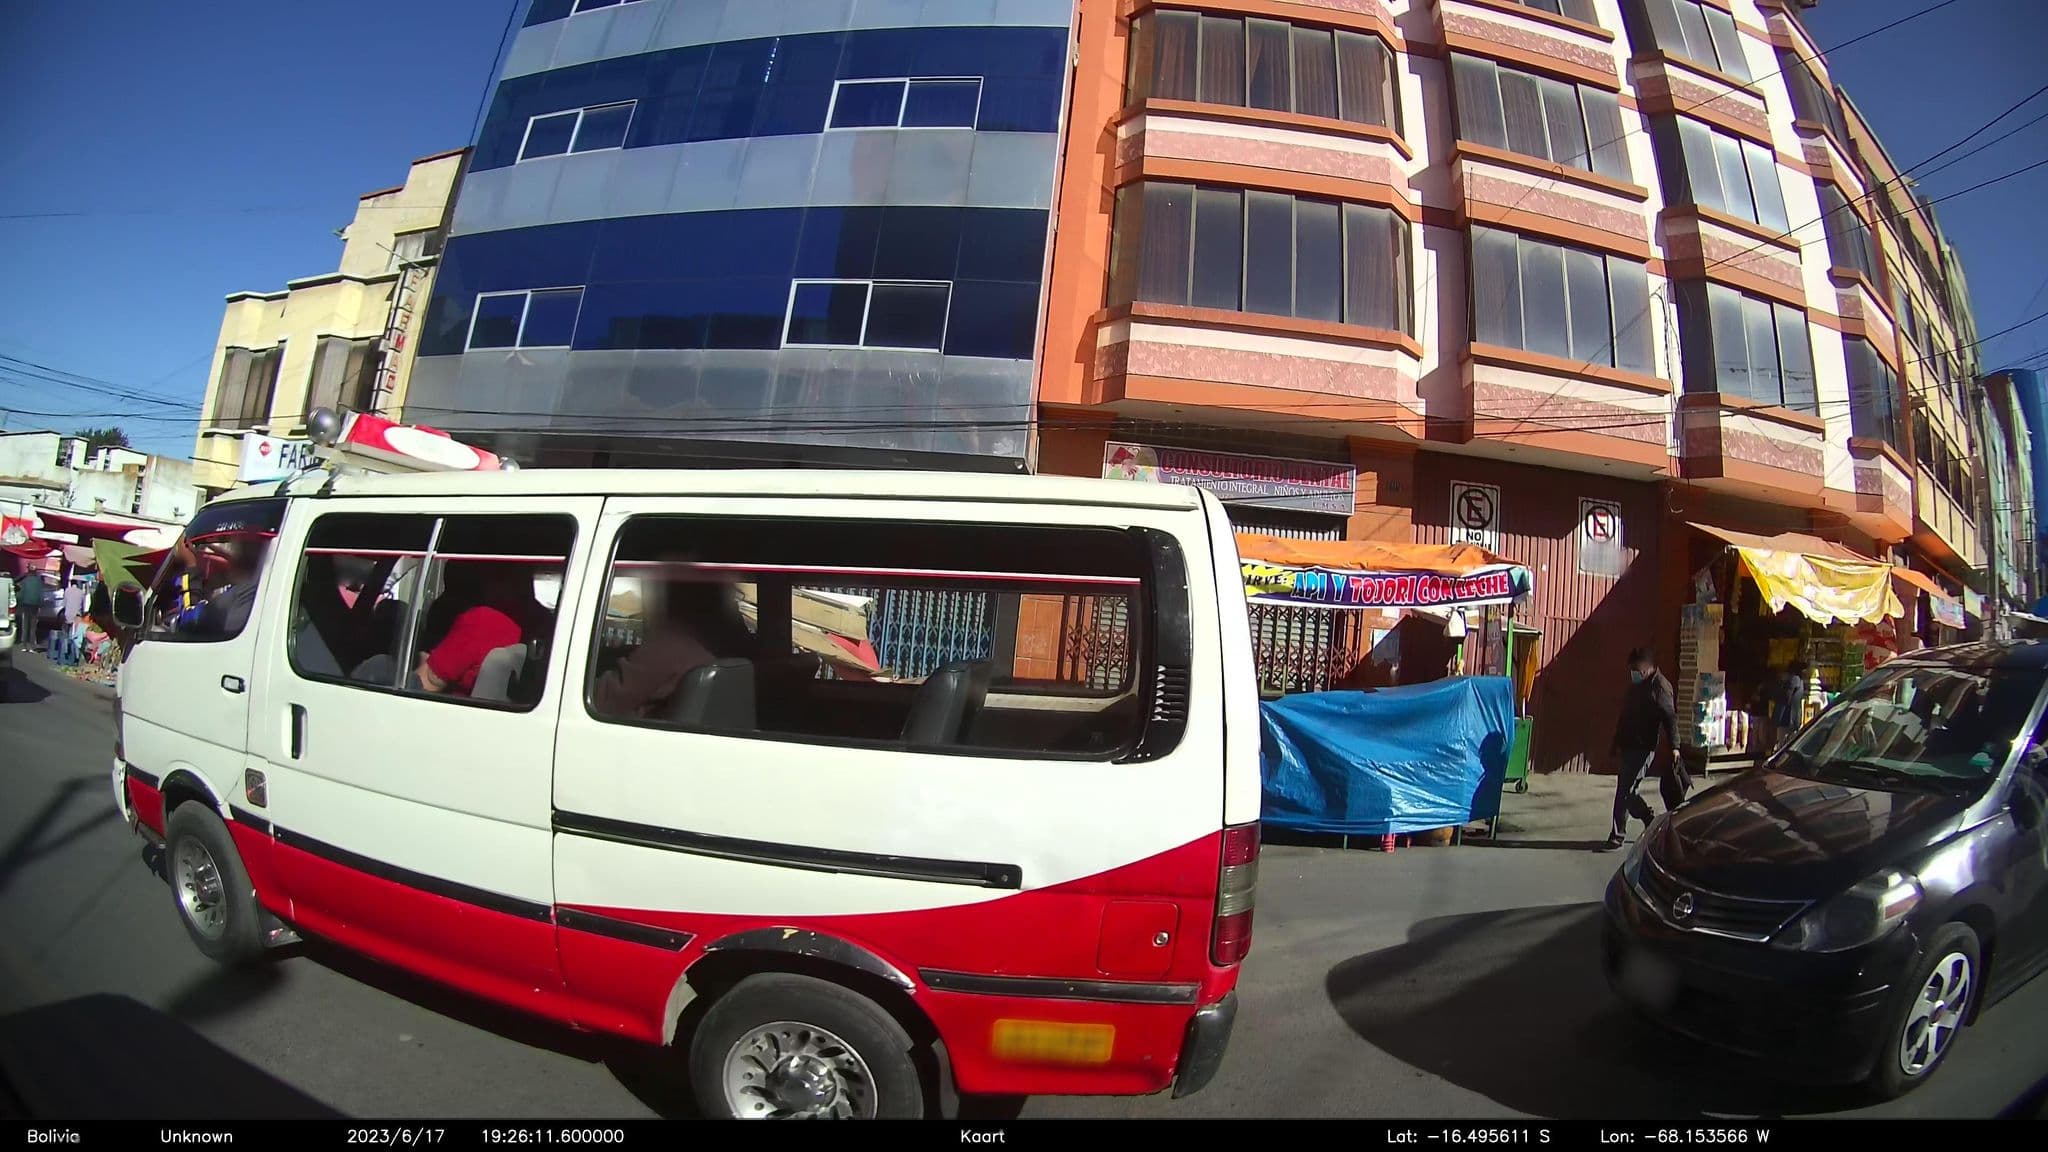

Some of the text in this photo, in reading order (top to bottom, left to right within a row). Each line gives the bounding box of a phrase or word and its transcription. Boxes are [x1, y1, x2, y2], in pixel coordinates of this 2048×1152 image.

[279, 443, 318, 469] FAR
[1170, 475, 1228, 491] TRATAMIENTO
[1228, 480, 1268, 495] INTEGRAL
[1274, 484, 1299, 497] NIÑOS
[1288, 462, 1350, 490] DENTAL
[1466, 531, 1482, 541] NO
[1244, 571, 1510, 605] IRVE: API Y TOJORI CON LECHE
